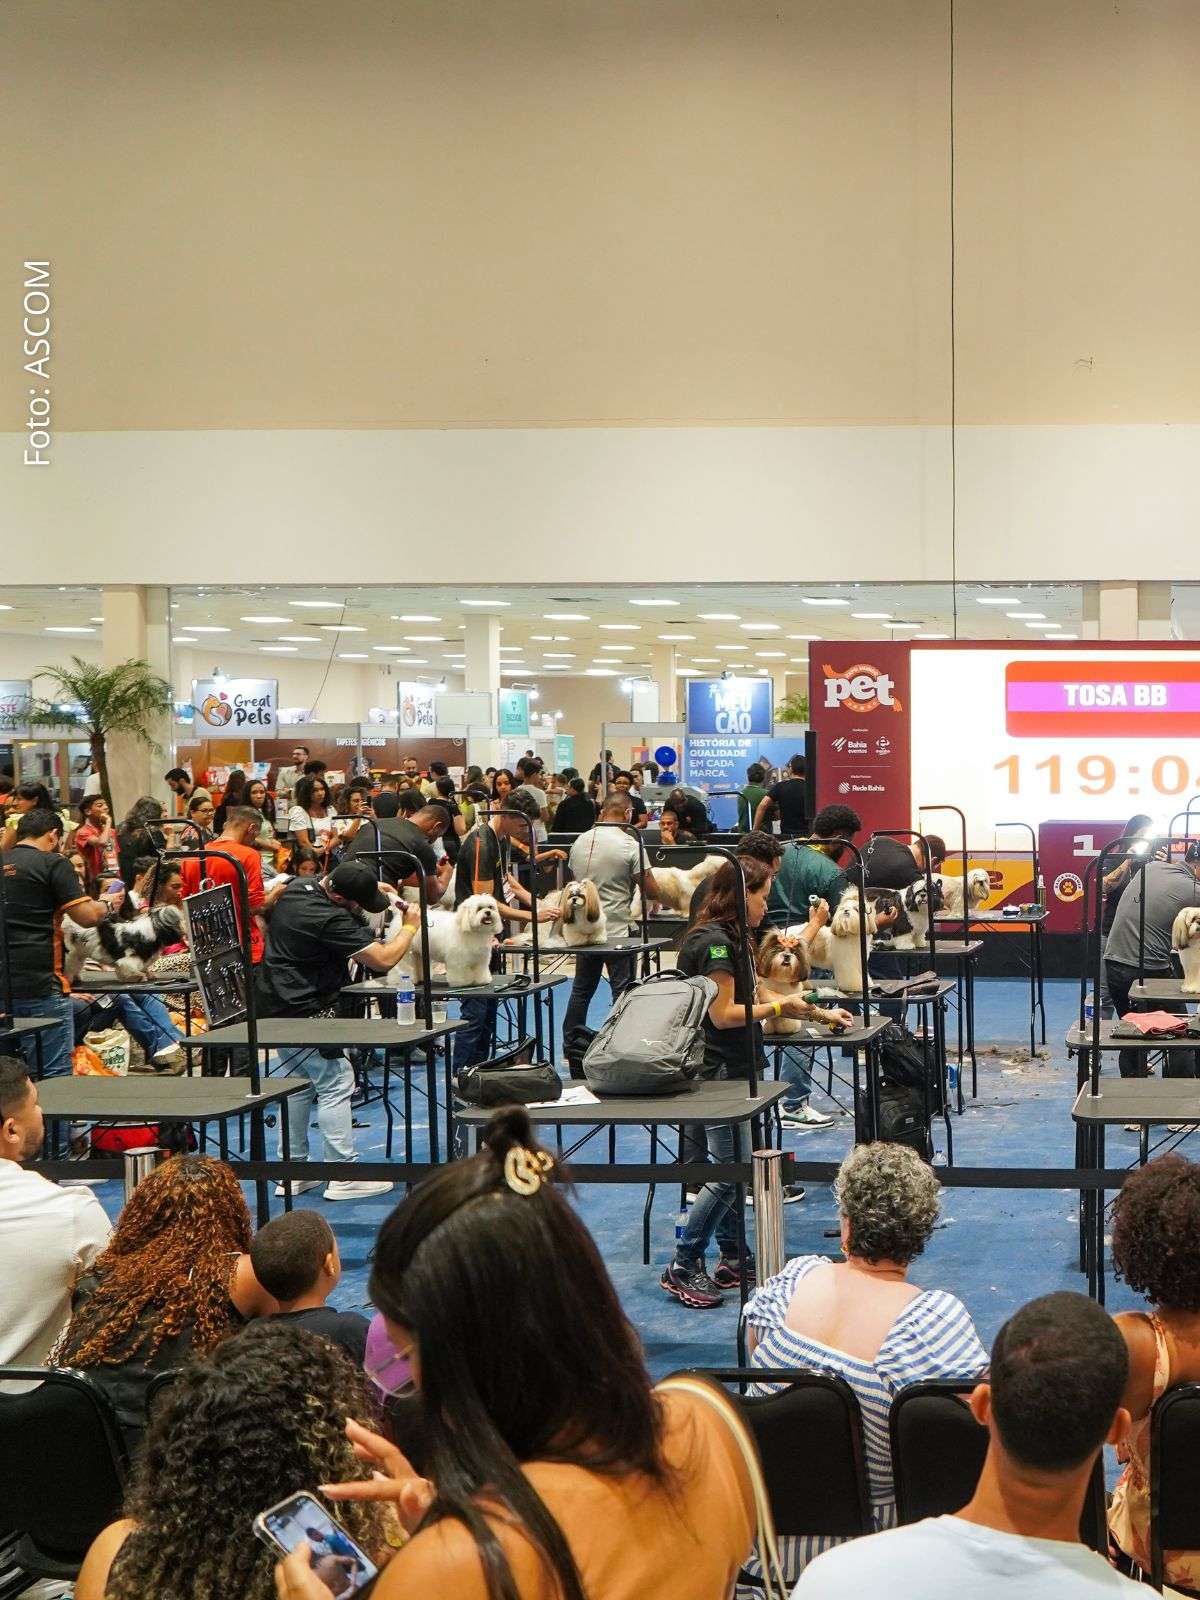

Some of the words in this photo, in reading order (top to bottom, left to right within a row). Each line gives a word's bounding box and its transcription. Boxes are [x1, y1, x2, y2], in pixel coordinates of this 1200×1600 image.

[824, 674, 895, 708] pet
[1064, 684, 1127, 707] TOSA
[1133, 684, 1168, 707] BB
[234, 694, 271, 708] Great
[234, 708, 271, 727] Pets
[689, 738, 736, 748] HISTÓRIA
[738, 739, 752, 748] DE
[690, 750, 748, 758] QUALIDADE
[690, 760, 704, 768] EM
[706, 760, 735, 768] CADA
[690, 770, 728, 778] MARCA.
[1073, 834, 1101, 856] 1
